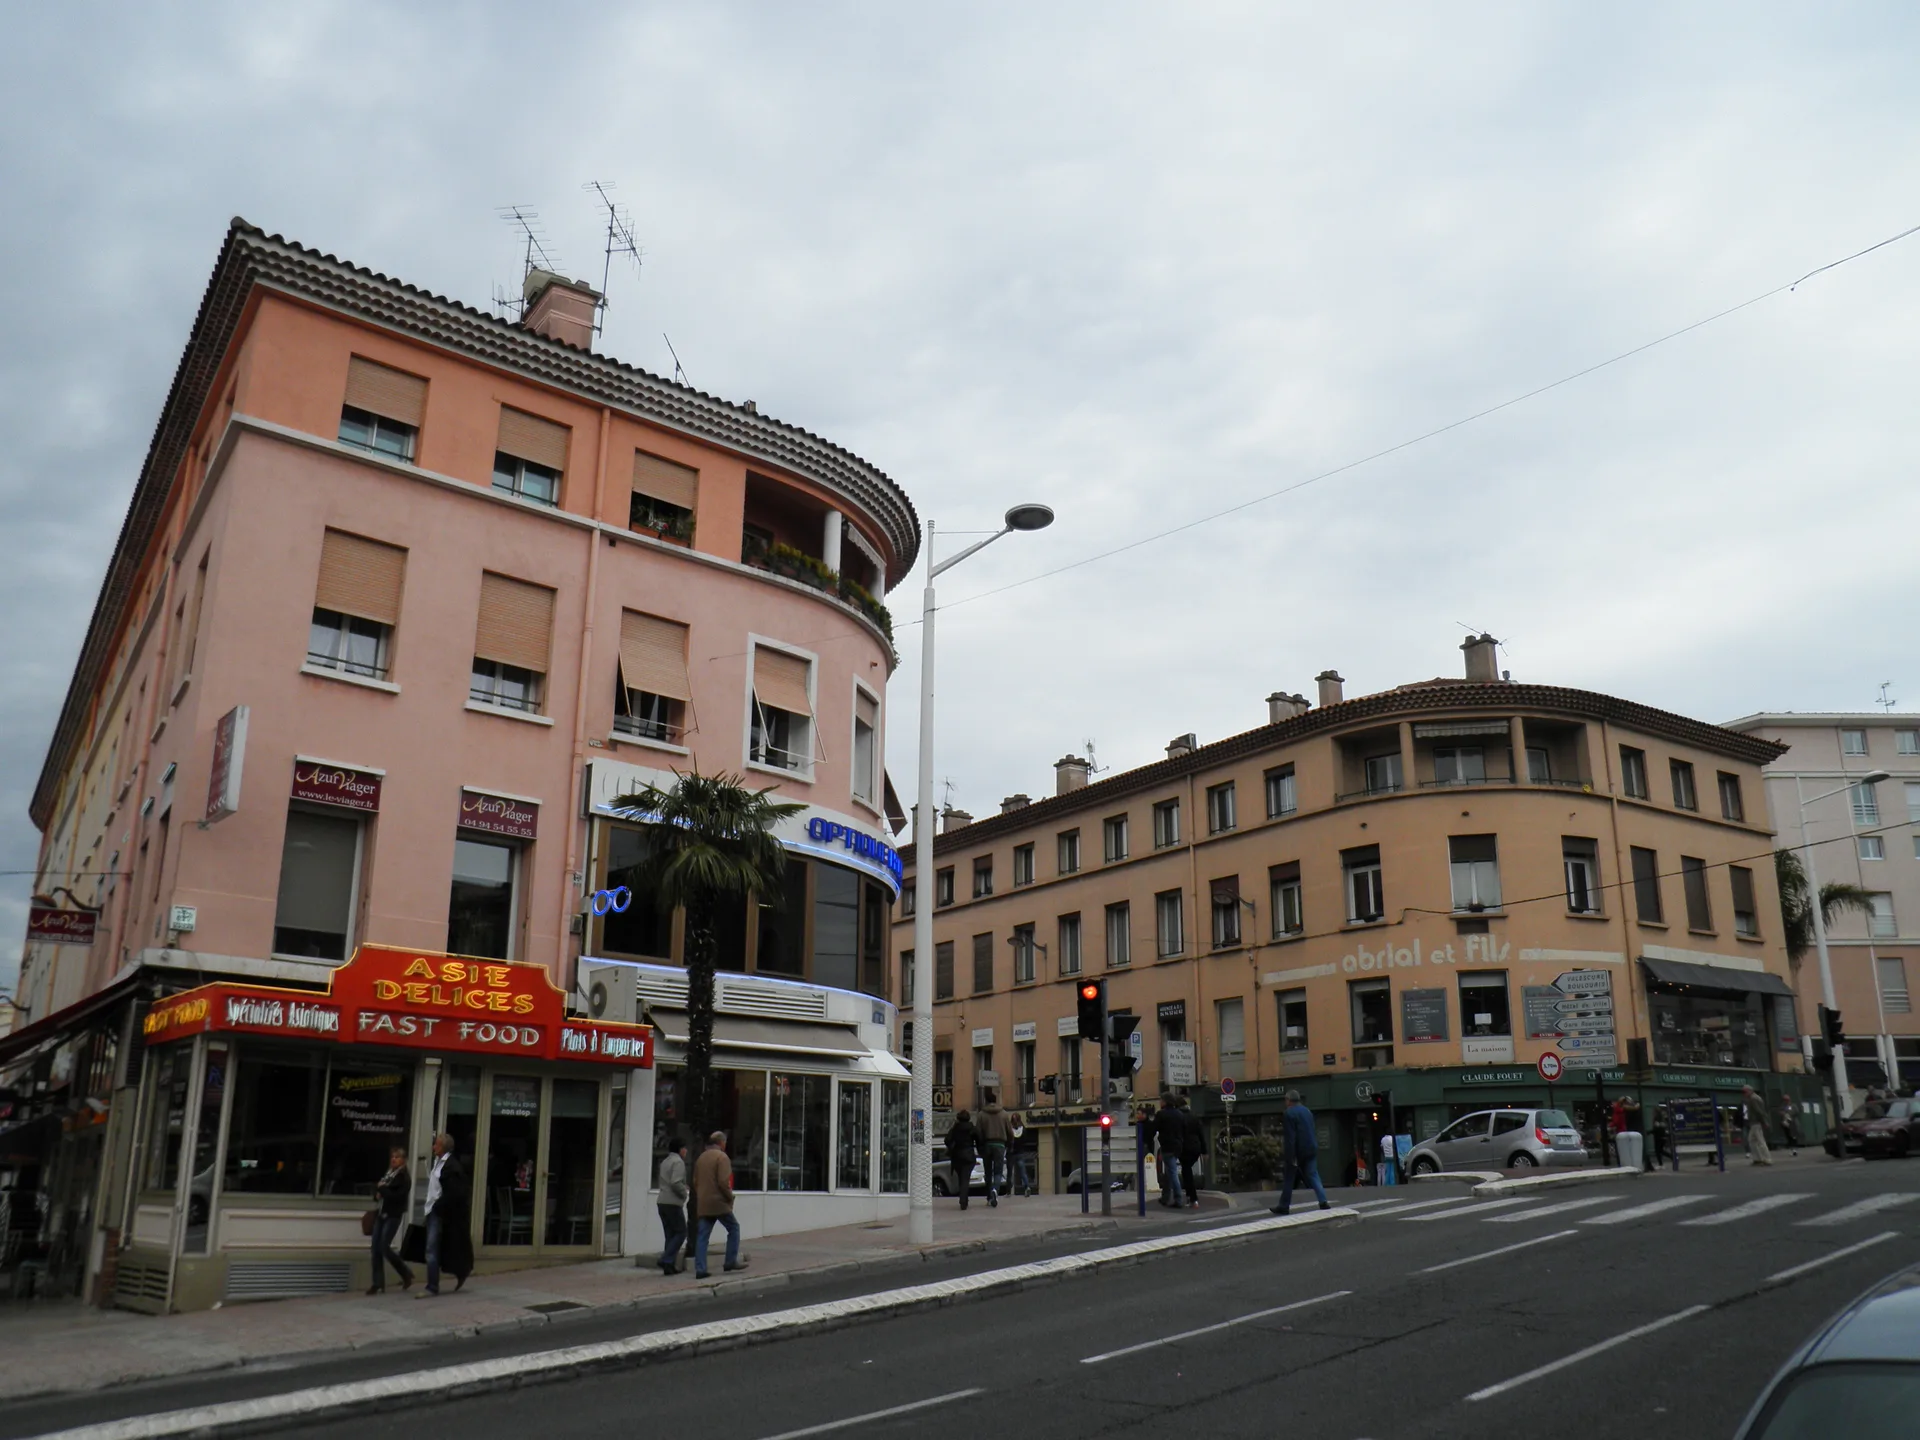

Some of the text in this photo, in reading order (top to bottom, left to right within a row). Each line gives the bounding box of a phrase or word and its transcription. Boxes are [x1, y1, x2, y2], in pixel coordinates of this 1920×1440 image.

[296, 766, 376, 797] Azur Viager
[298, 790, 375, 809] www.le-viager.fr
[462, 795, 533, 825] Azur Viager
[464, 818, 532, 836] 04 94 54 55 55
[1342, 938, 1422, 973] abrial
[1430, 944, 1456, 964] et
[404, 958, 512, 987] ASIE
[1567, 974, 1605, 982] VALESCURE
[1567, 982, 1605, 990] BOULOURIS
[373, 980, 535, 1014] DELICES
[173, 998, 209, 1025] FOOD
[358, 1012, 540, 1046] FAST FOOD
[1014, 1028, 1030, 1037] Allianz
[561, 1028, 587, 1053] Plats
[601, 1032, 645, 1059] Emporter
[1467, 1044, 1479, 1053] La
[1462, 1072, 1524, 1082] CLAUDE FOUET
[933, 1091, 952, 1106] OR
[1245, 1086, 1284, 1095] CLAUDE FOUET
[516, 1109, 531, 1118] stop
